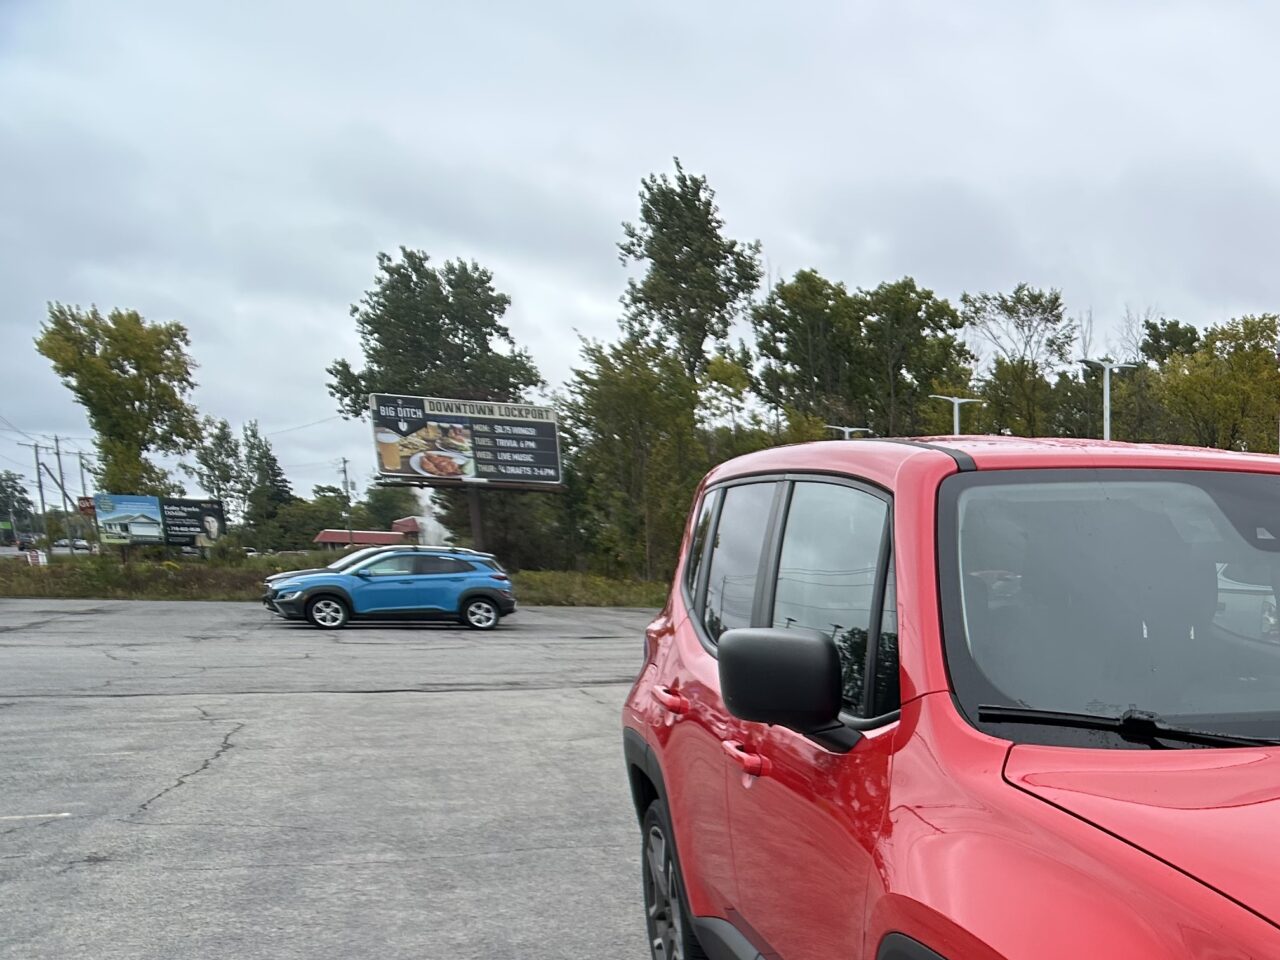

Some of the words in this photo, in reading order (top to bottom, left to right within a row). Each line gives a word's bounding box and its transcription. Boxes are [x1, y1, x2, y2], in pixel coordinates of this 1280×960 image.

[380, 405, 395, 416] BIG
[397, 407, 423, 418] DITCH
[428, 400, 494, 416] DOWNTOWN
[498, 406, 551, 421] LOCKPORT
